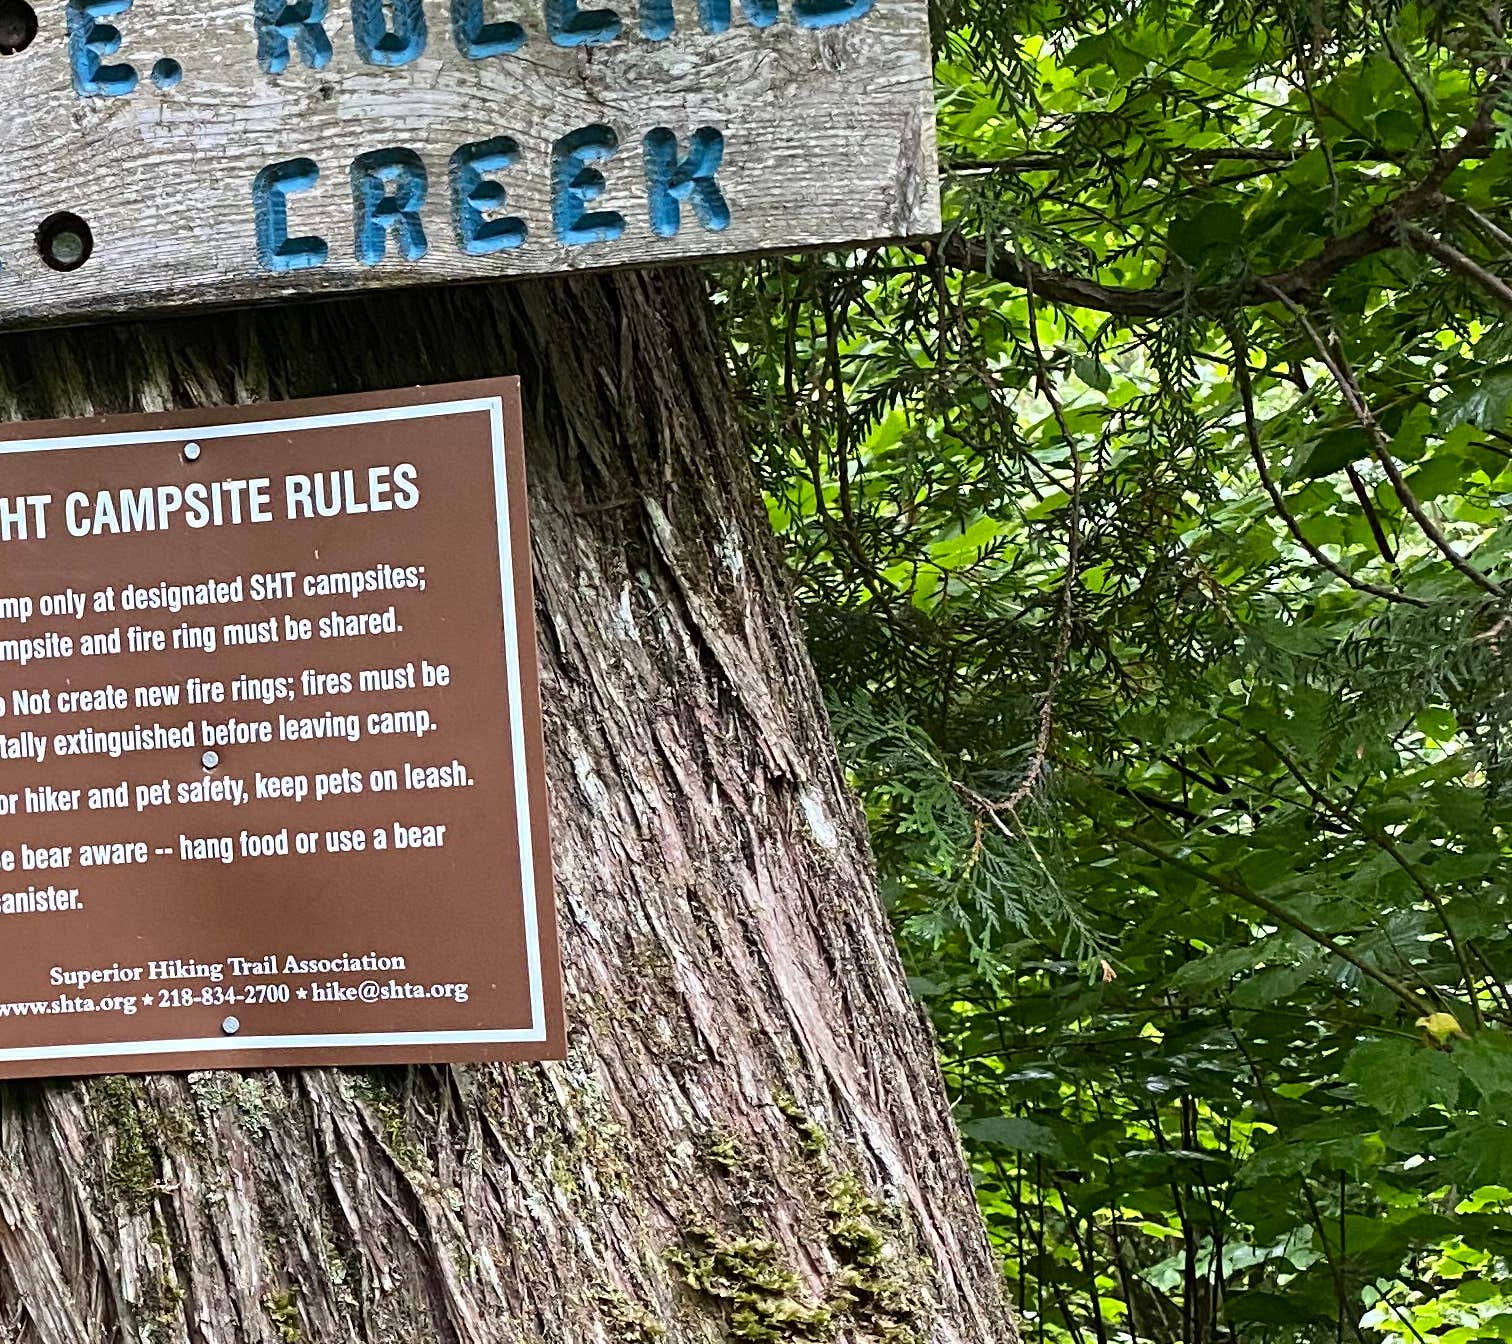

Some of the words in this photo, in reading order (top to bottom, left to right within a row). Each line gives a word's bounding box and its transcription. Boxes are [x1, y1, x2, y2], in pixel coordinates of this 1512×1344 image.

[252, 122, 731, 273] CREEK
[65, 477, 273, 537] CAMPSITE
[285, 463, 420, 520] RULES
[39, 588, 87, 620] only
[93, 586, 116, 613] at
[121, 575, 244, 613] designated
[249, 571, 297, 601] SHT
[302, 563, 426, 599] campsites;
[79, 627, 122, 656] and
[126, 625, 166, 653] fire
[172, 622, 217, 653] ring
[223, 616, 279, 646] must
[284, 614, 313, 641] be
[318, 606, 403, 639] shared.
[11, 688, 52, 716] Not
[57, 685, 128, 713] create
[134, 684, 180, 708] new
[186, 677, 225, 705] fire
[231, 674, 295, 705] rings;
[300, 669, 353, 696] fires
[359, 662, 416, 692] must
[421, 660, 450, 688] be
[53, 720, 195, 758] extinguished
[201, 718, 273, 747] before
[278, 711, 361, 742] leaving
[367, 709, 437, 738] camp.
[24, 785, 81, 814] hiker
[87, 781, 129, 810] and
[135, 779, 172, 812] pet
[176, 774, 249, 806] safety,
[255, 772, 309, 803] keep
[315, 767, 364, 801] pets
[369, 769, 398, 792] on
[404, 759, 474, 790] leash.
[21, 843, 73, 870] bear
[79, 842, 148, 867] aware
[179, 834, 234, 864] hang
[239, 828, 289, 857] food
[295, 832, 319, 855] or
[325, 829, 366, 853] use
[372, 828, 388, 850] a
[393, 821, 447, 849] bear
[49, 962, 144, 990] Superior
[147, 959, 224, 982] Hiking
[226, 954, 279, 976] Trail
[282, 951, 406, 974] Association
[157, 983, 290, 1008] 218-834-2700
[310, 979, 469, 1003] hike@shta.org
